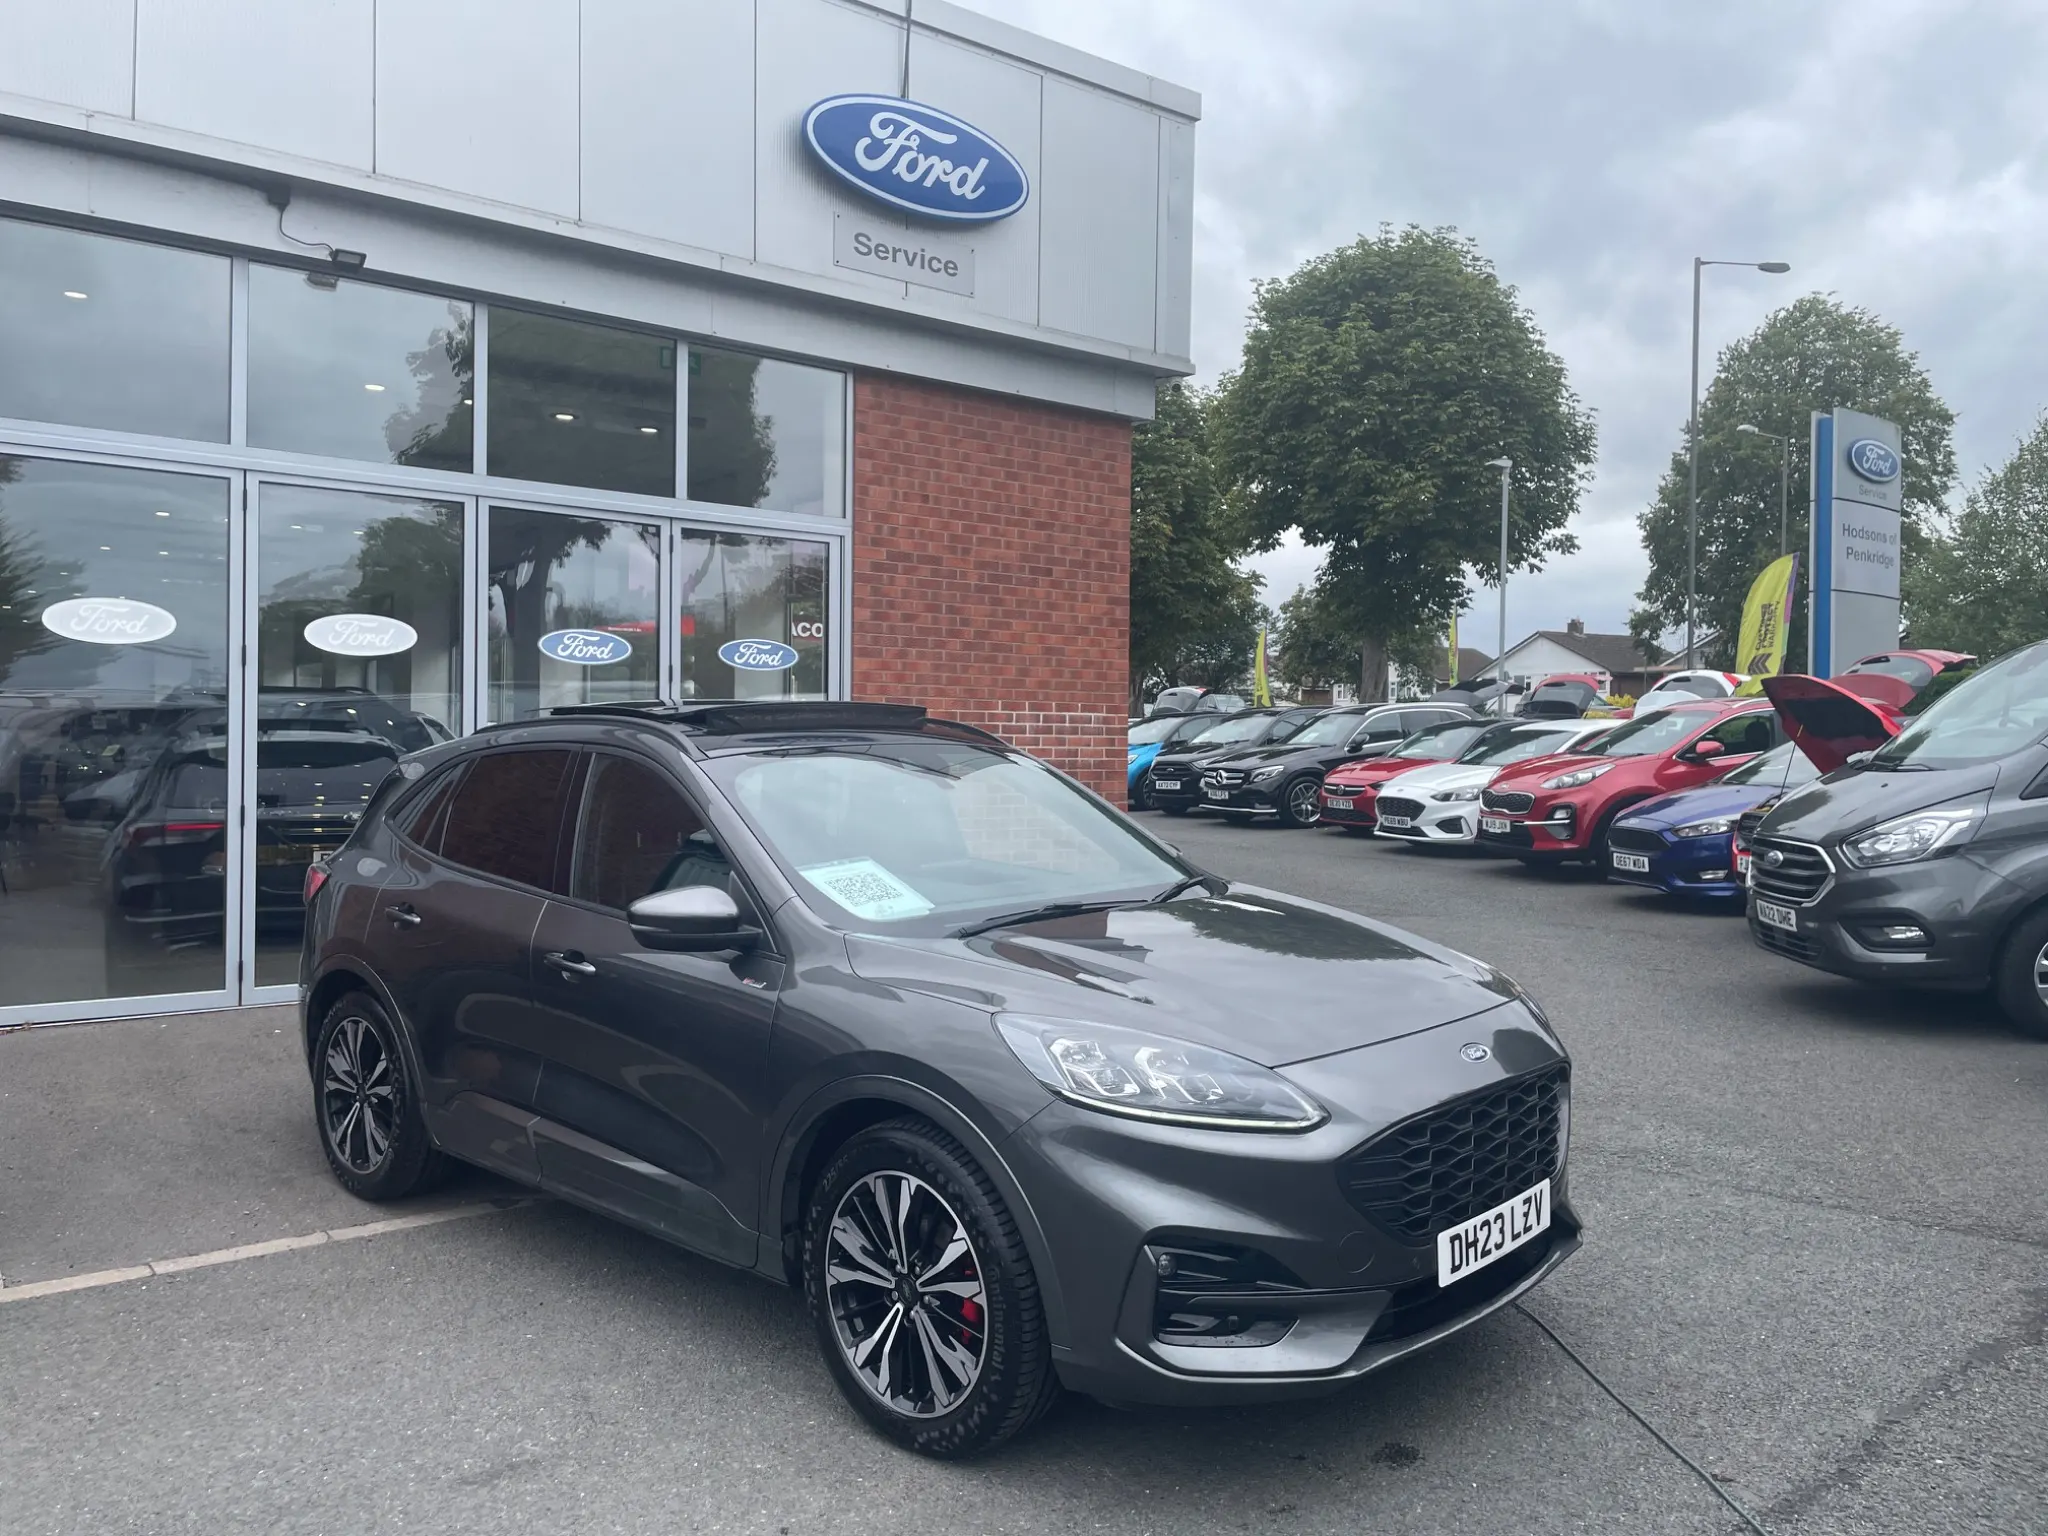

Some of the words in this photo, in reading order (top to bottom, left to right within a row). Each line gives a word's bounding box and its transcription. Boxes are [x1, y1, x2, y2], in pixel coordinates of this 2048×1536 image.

[855, 111, 989, 200] Ford
[853, 232, 959, 277] Service
[1862, 444, 1893, 475] Ford
[1858, 484, 1887, 501] Service
[1842, 523, 1888, 544] Hodsons
[1889, 533, 1898, 546] of
[1846, 546, 1895, 570] Penkridge
[69, 603, 150, 634] Ford
[328, 619, 396, 647] Ford
[557, 633, 615, 659] Ford
[733, 642, 784, 666] Ford
[1449, 1211, 1505, 1275] DH23
[1511, 1188, 1543, 1242] LZV
